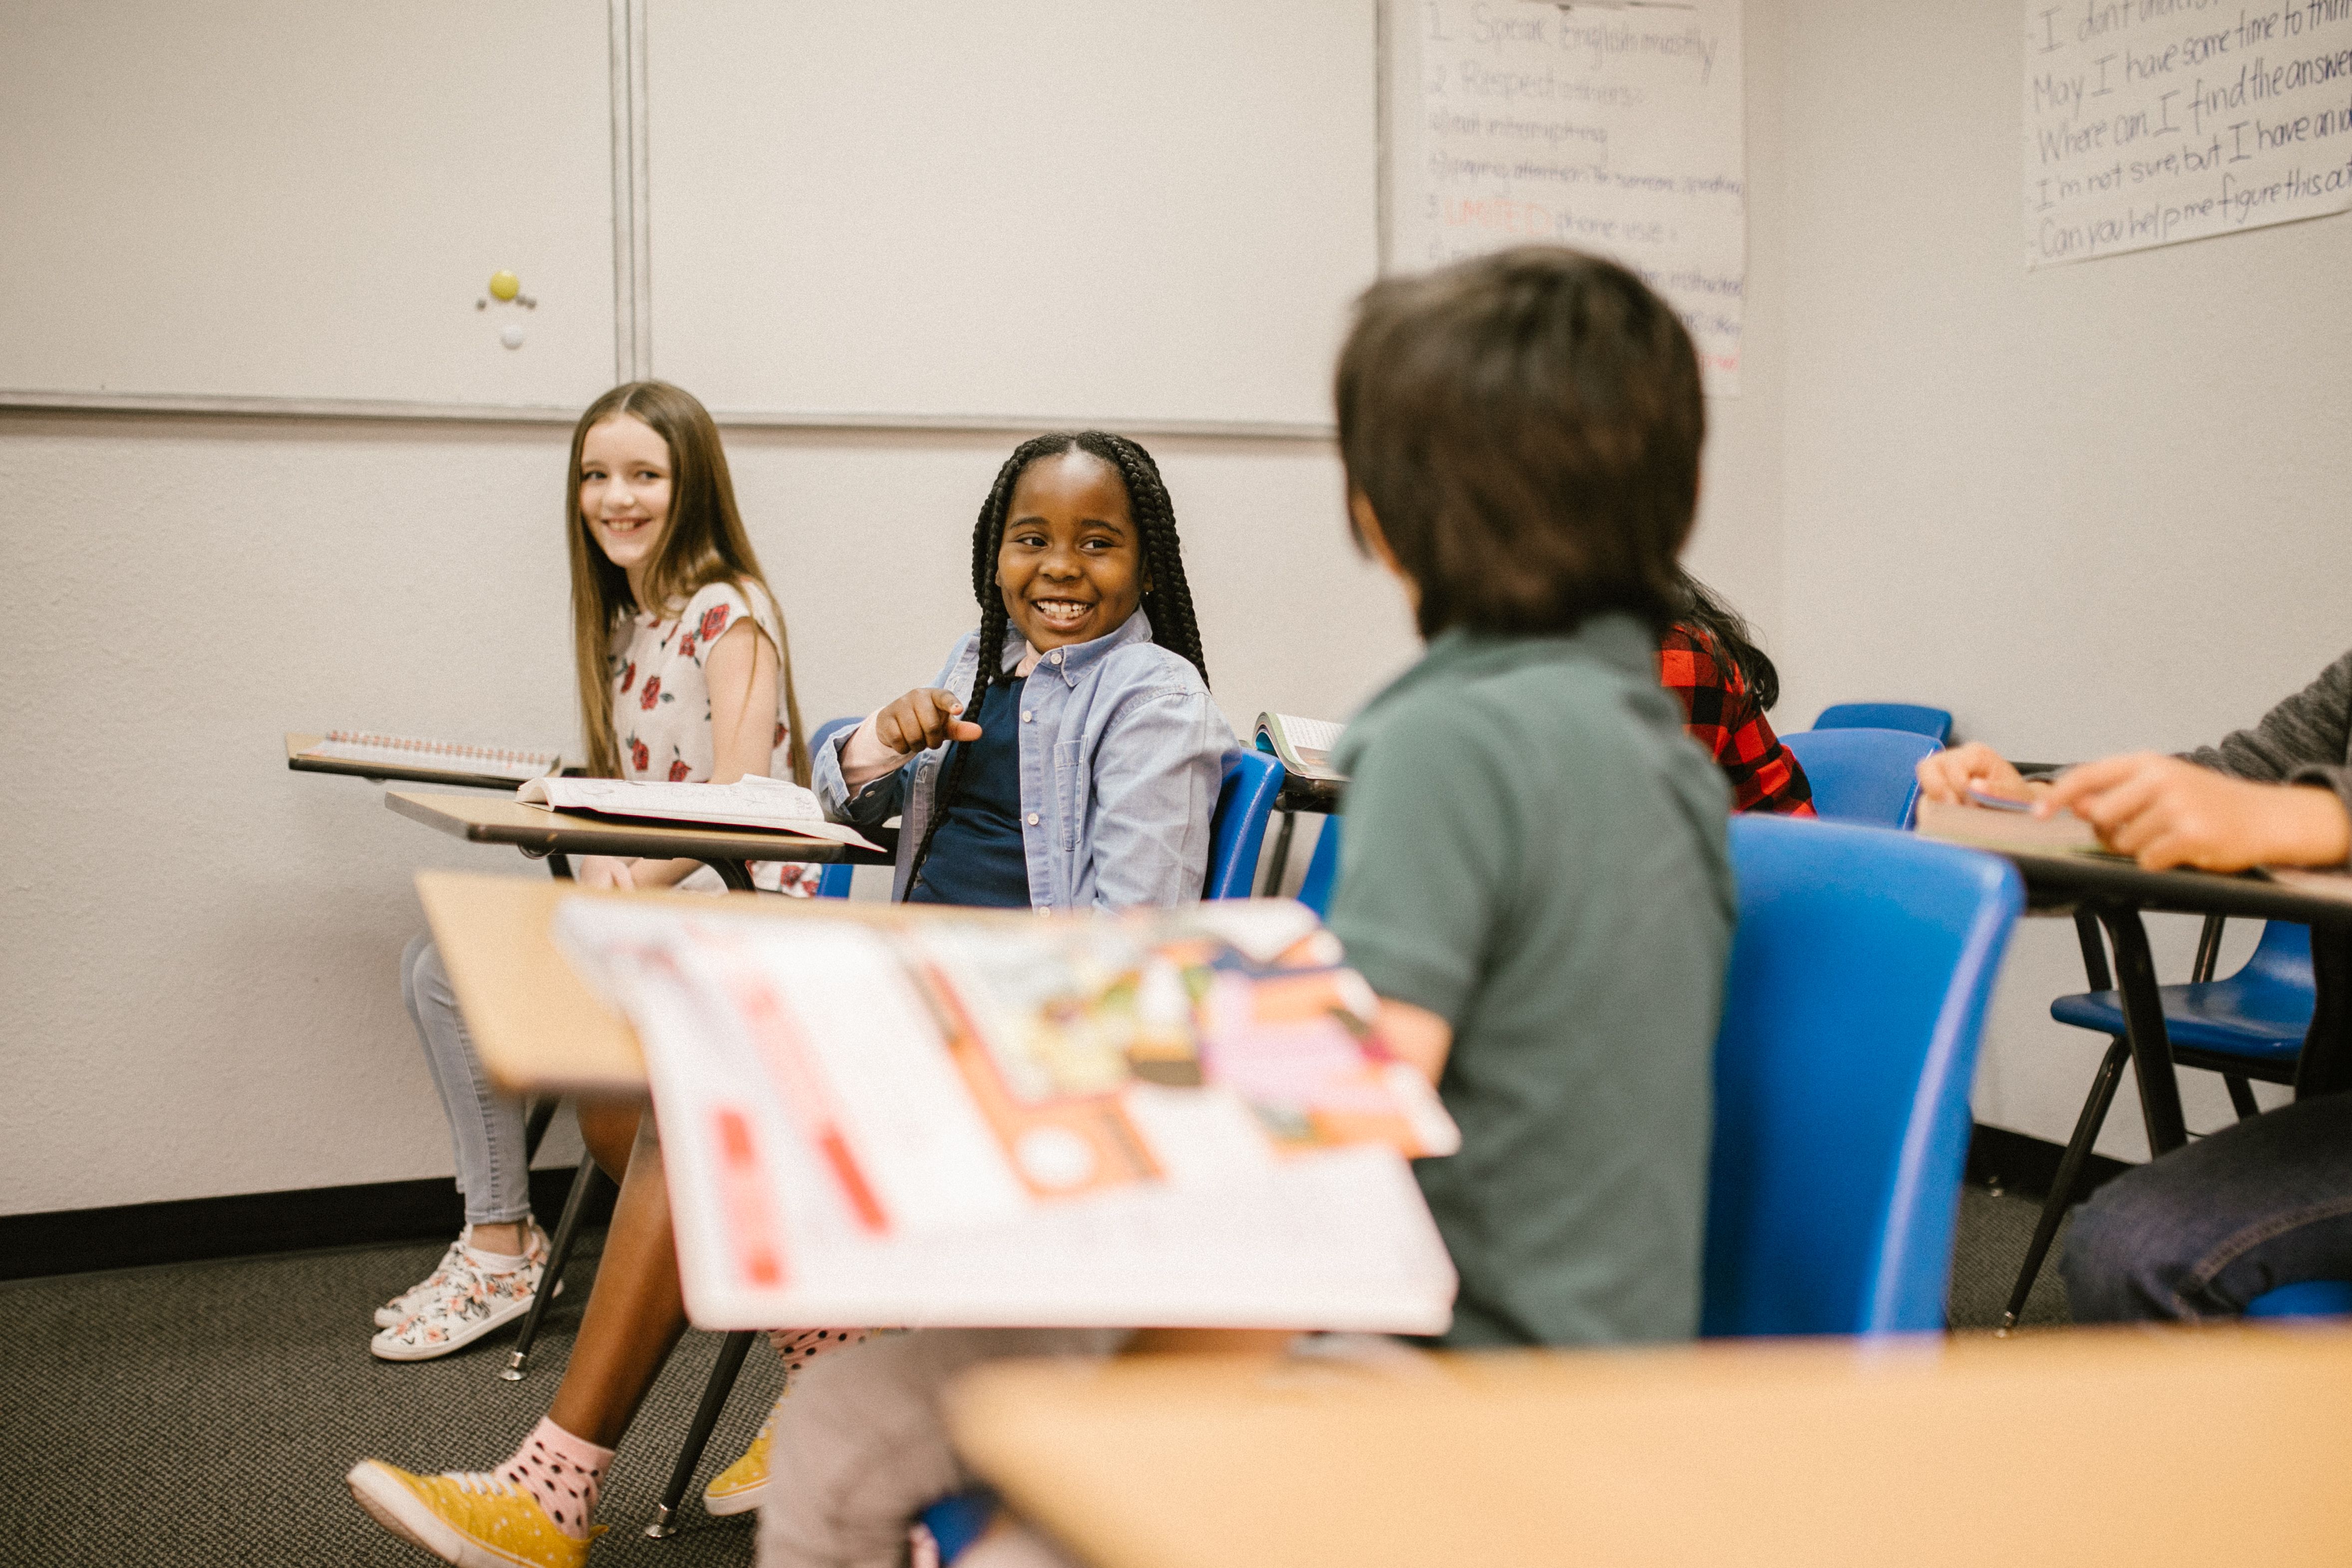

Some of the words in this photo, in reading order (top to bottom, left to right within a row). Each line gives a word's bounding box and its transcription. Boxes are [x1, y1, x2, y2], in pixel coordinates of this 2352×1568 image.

[1471, 2, 1552, 54] Speak
[1559, 15, 1638, 70] English
[1641, 23, 1718, 86] mostly
[2034, 72, 2085, 122] May
[2091, 52, 2118, 97] I
[2126, 47, 2178, 83] have
[2183, 29, 2231, 65] some
[2235, 8, 2279, 49] time
[2285, 0, 2303, 38] to
[2038, 5, 2065, 55] I
[2077, 0, 2133, 42] dont
[1458, 59, 1555, 101] Respect
[2037, 116, 2108, 165] Where
[2114, 111, 2148, 146] can
[2153, 89, 2181, 138] I
[2188, 77, 2247, 136] find
[2250, 56, 2284, 101] the
[2035, 175, 2081, 212] I'm
[2088, 161, 2122, 193] not
[2129, 152, 2180, 183] sure,
[2183, 132, 2222, 171] but
[2227, 119, 2253, 164] I
[2256, 116, 2311, 151] have
[2314, 108, 2336, 139] an
[1444, 196, 1554, 237] LIMITED
[1555, 210, 1618, 245] phone
[2039, 216, 2083, 258] Can
[2087, 218, 2123, 255] you
[2128, 200, 2181, 242] help
[2184, 197, 2214, 221] me
[2216, 171, 2283, 224] figure
[2286, 165, 2322, 202] this
